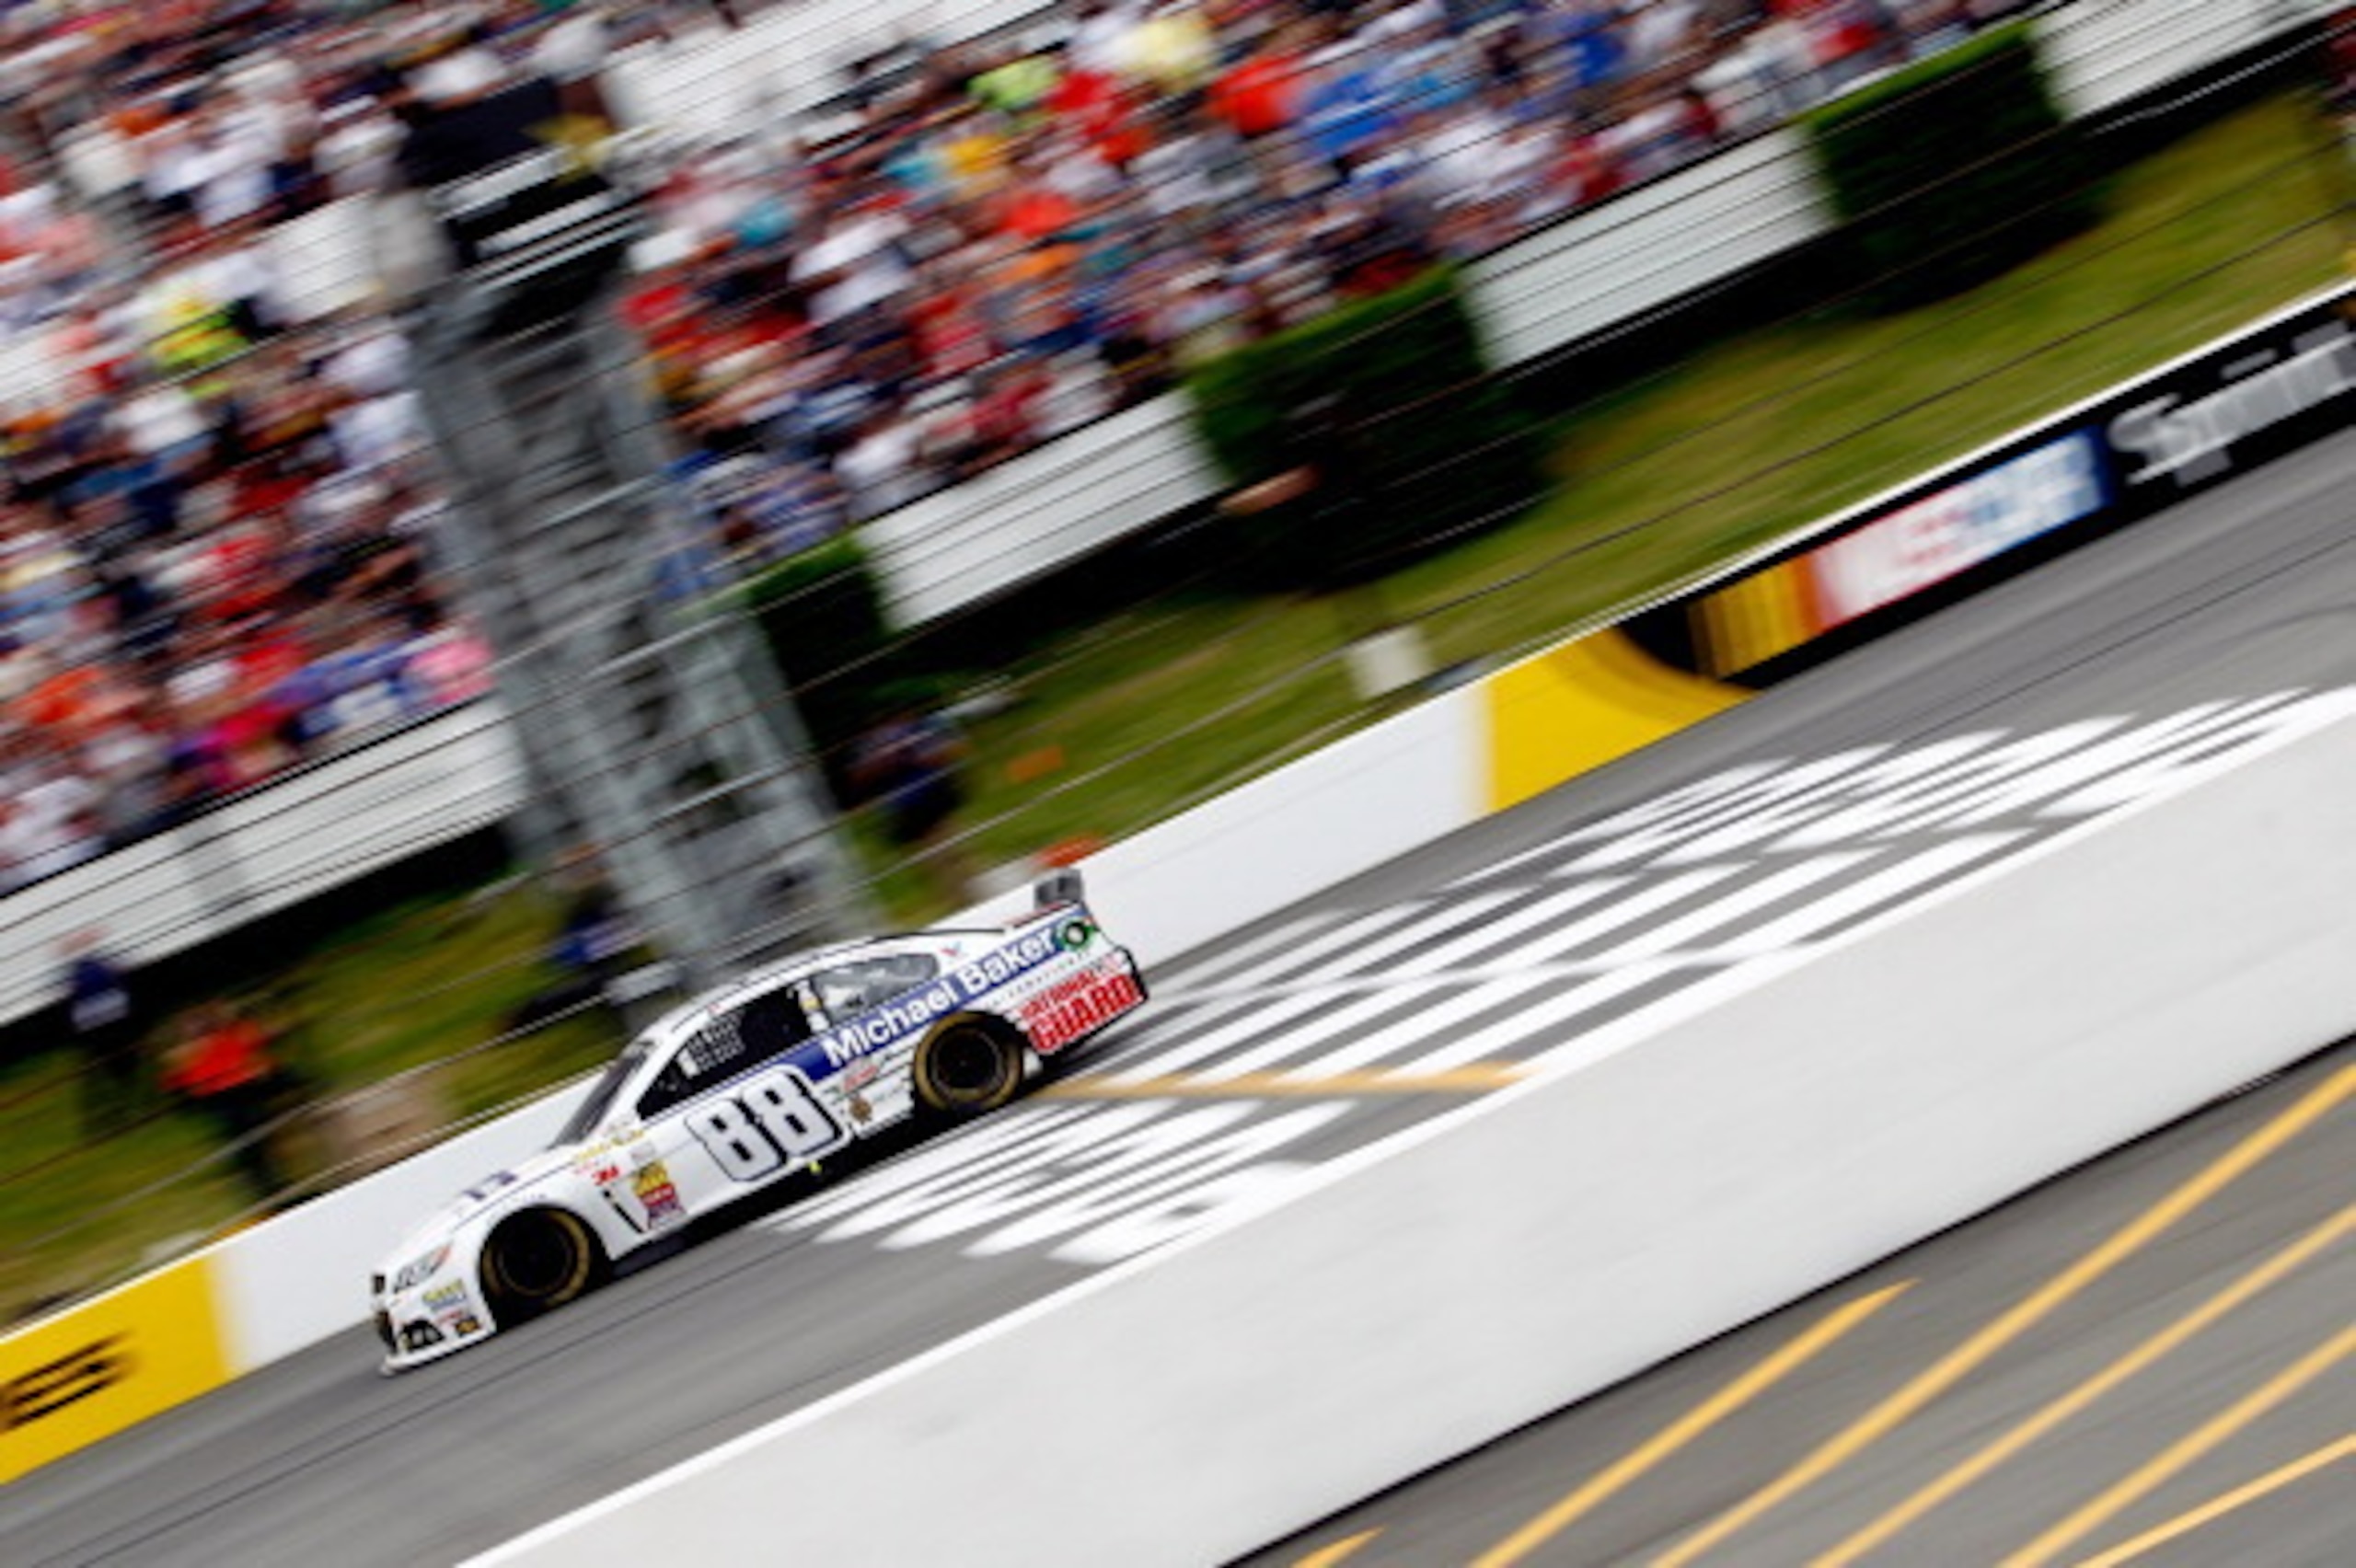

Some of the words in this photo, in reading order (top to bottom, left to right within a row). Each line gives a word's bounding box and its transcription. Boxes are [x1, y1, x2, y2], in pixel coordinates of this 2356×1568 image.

[820, 981, 959, 1067] Michael
[958, 927, 1056, 995] Baker
[1028, 974, 1138, 1051] GUARD
[683, 1067, 843, 1183] 88
